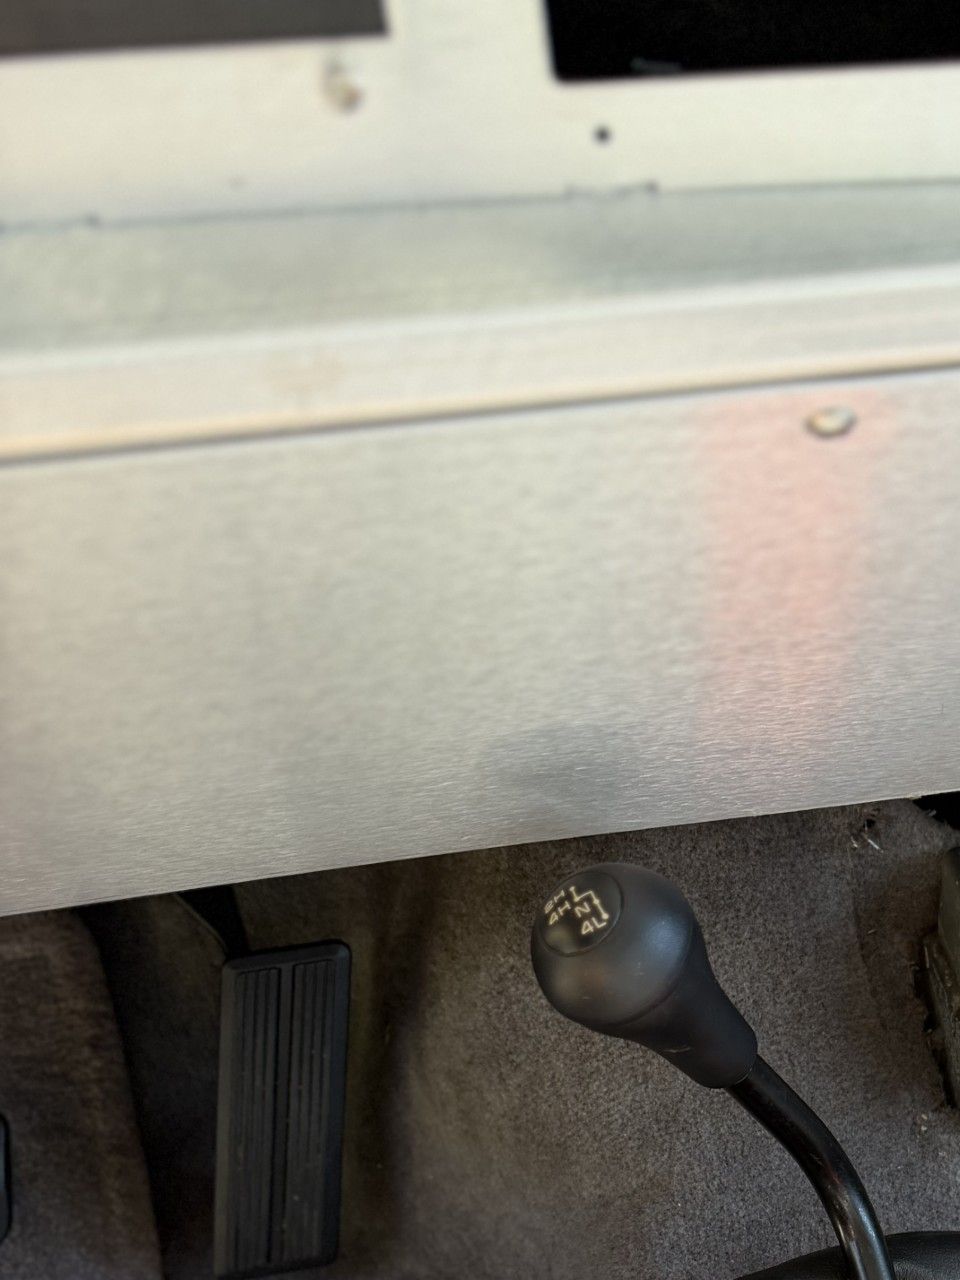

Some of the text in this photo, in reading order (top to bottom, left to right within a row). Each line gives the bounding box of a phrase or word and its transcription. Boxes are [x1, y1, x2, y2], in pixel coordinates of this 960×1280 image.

[549, 900, 571, 925] 4H
[574, 901, 591, 918] N
[581, 917, 607, 935] 4L
